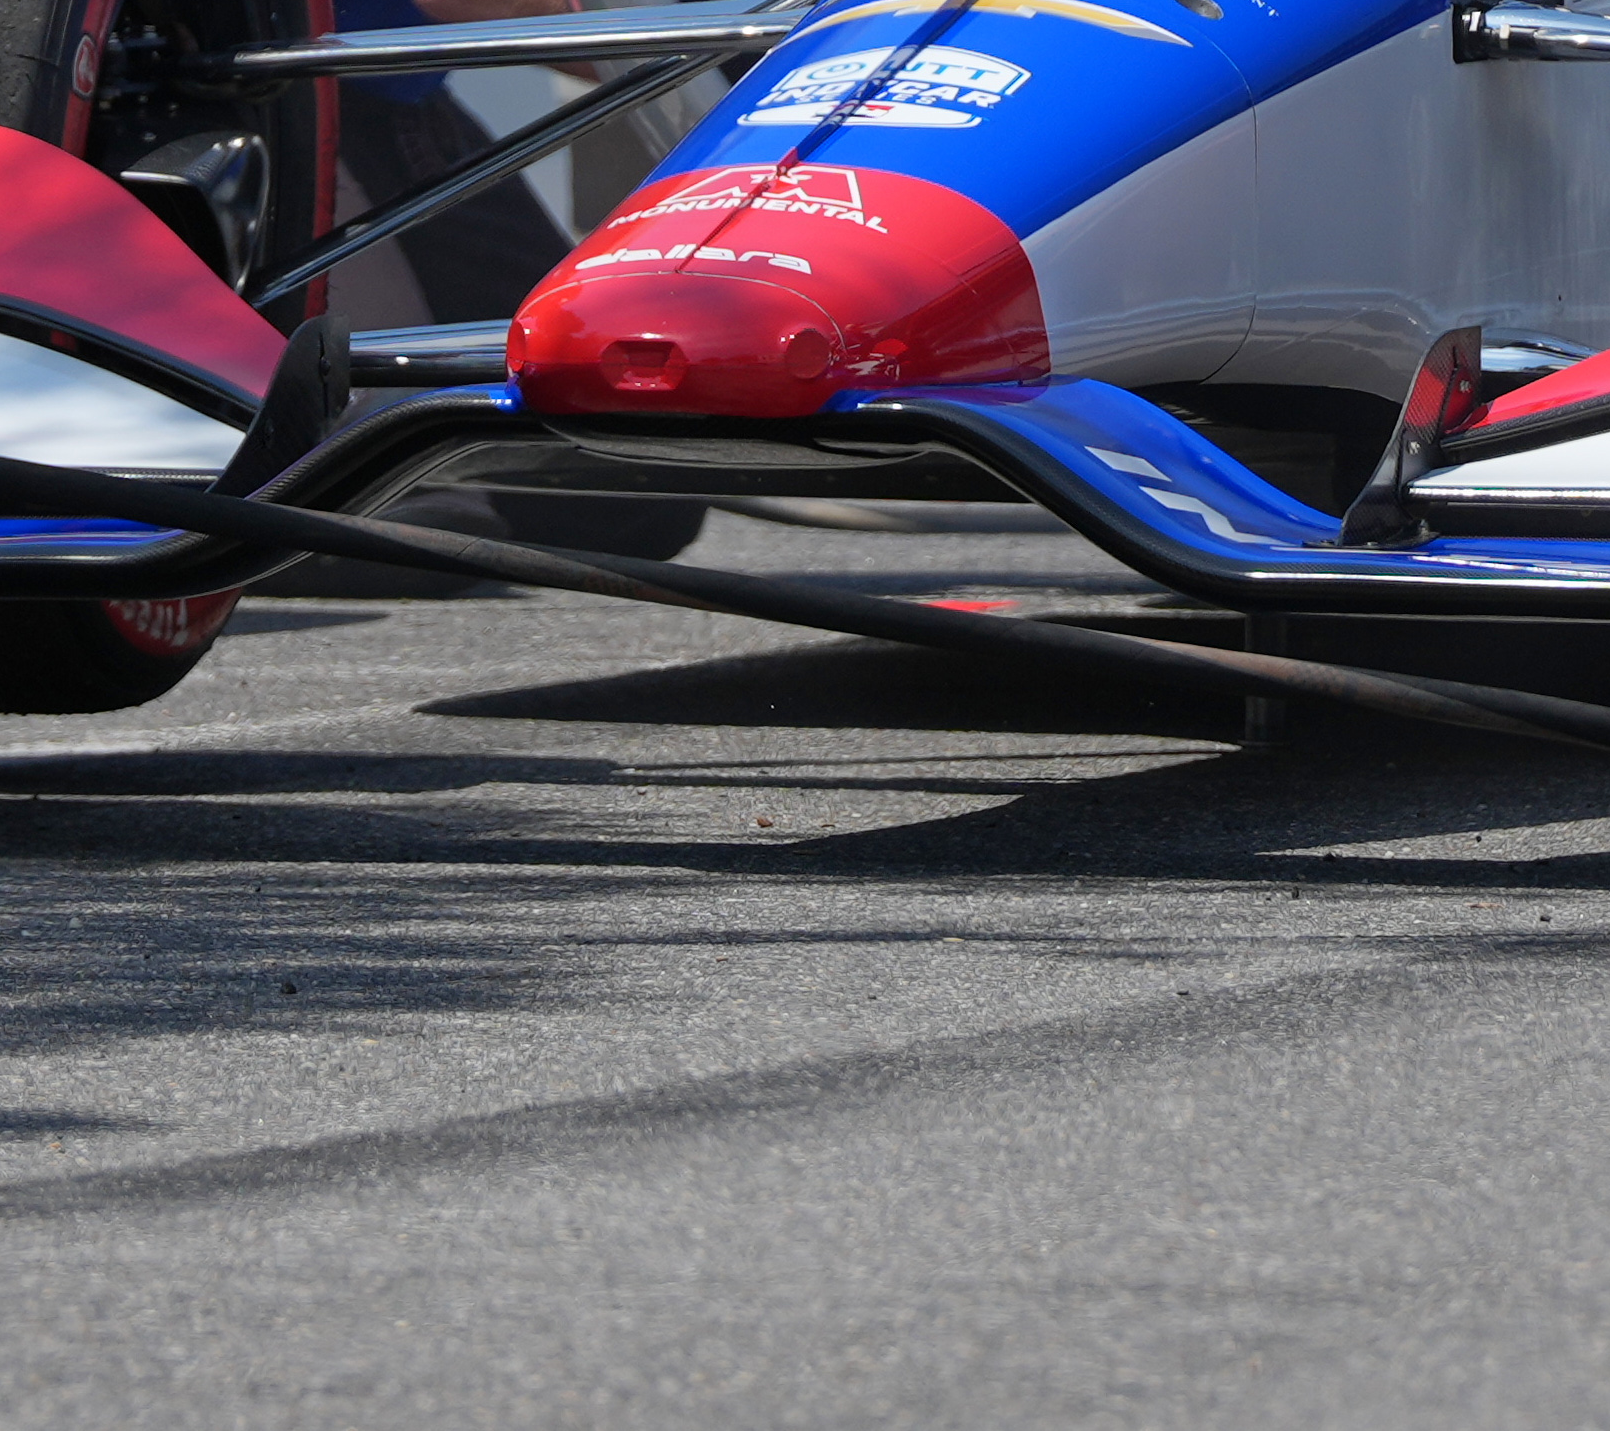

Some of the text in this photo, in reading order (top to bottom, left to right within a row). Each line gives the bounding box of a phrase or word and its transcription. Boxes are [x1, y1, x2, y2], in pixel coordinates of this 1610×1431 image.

[756, 79, 1002, 109] INDCAR
[795, 90, 939, 105] SEIES
[607, 196, 888, 234] MONUMENTAL
[574, 244, 813, 276] dallara
